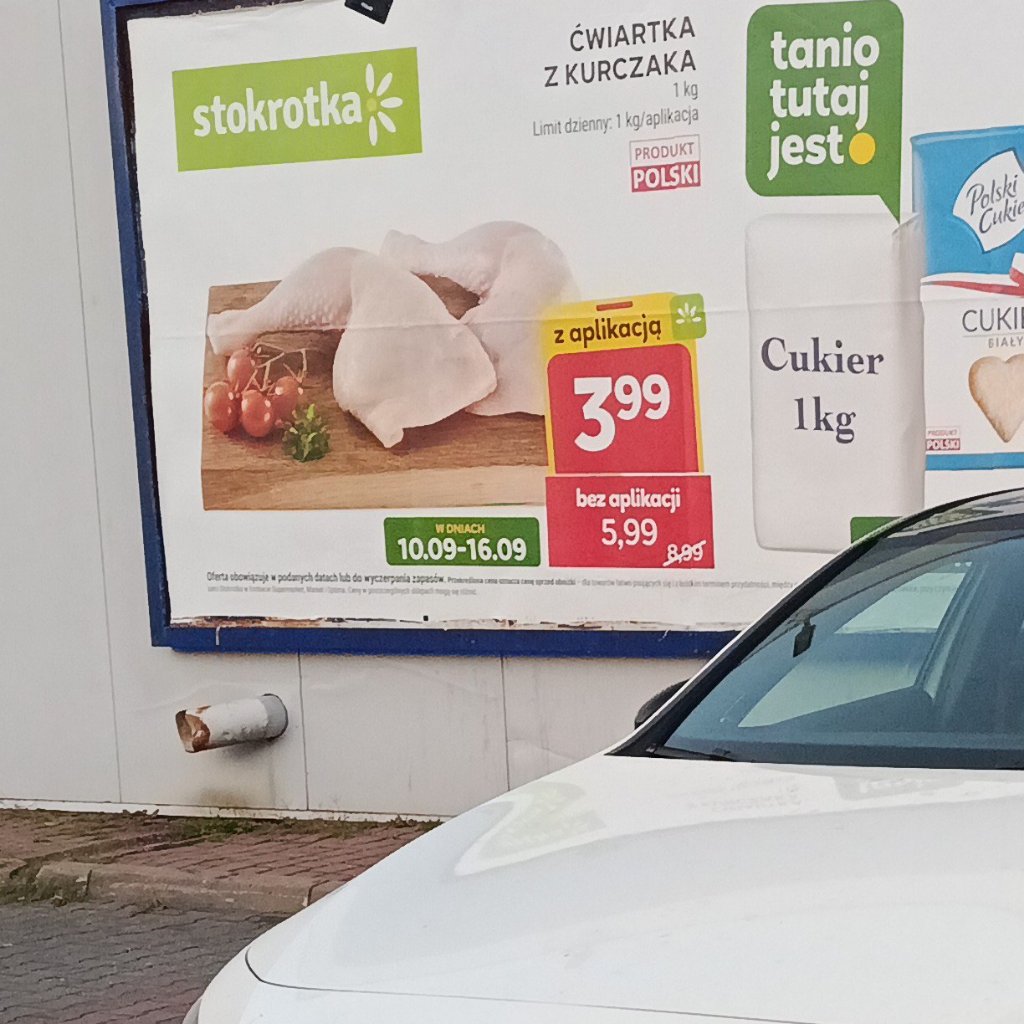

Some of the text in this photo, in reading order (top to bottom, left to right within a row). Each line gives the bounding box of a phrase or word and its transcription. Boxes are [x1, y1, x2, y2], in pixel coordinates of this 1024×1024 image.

[570, 16, 696, 51] ĆWIARTKA
[770, 20, 880, 70] tanio
[544, 49, 697, 88] Z KURCZAKA
[674, 80, 698, 100] 1 kg
[769, 69, 869, 131] tutaj
[193, 81, 362, 138] stokrotka
[533, 105, 699, 137] Limit dzienny: 1 kg/aplikacja
[635, 142, 695, 160] PRODUKT
[632, 163, 699, 190] POLSKI
[966, 173, 1018, 215] Polski
[553, 314, 662, 348] z aplikacją
[988, 335, 1024, 349] BIAŁY
[761, 336, 884, 375] Cukier
[575, 487, 681, 513] bez aplikacji
[435, 523, 486, 534] W DNIACH
[601, 518, 658, 550] 5,99
[397, 537, 527, 561] 10.09-16.09
[664, 541, 705, 565] 8,99
